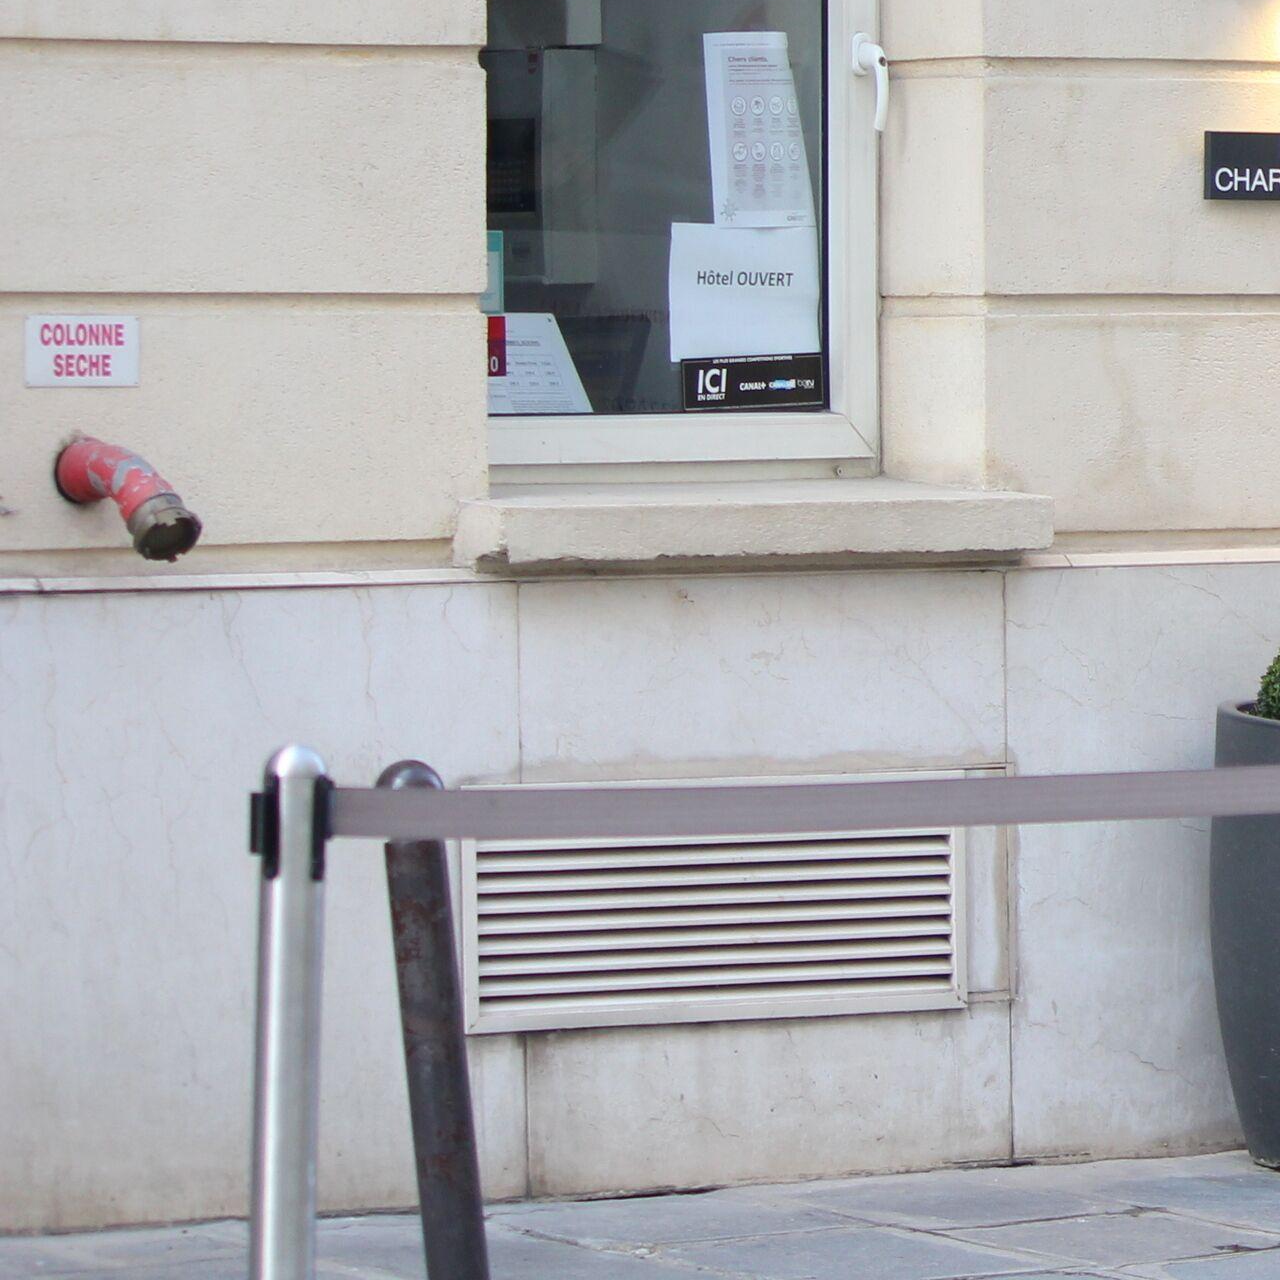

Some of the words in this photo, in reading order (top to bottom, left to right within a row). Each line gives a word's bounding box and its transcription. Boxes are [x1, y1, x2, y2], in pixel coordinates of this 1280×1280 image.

[697, 270, 734, 286] Hôtel
[737, 271, 794, 287] OUVERT
[40, 323, 125, 346] COLONNE
[53, 354, 112, 377] SECHE
[697, 368, 728, 394] ICI
[739, 381, 767, 391] CANAL+
[707, 393, 726, 401] DIRECT
